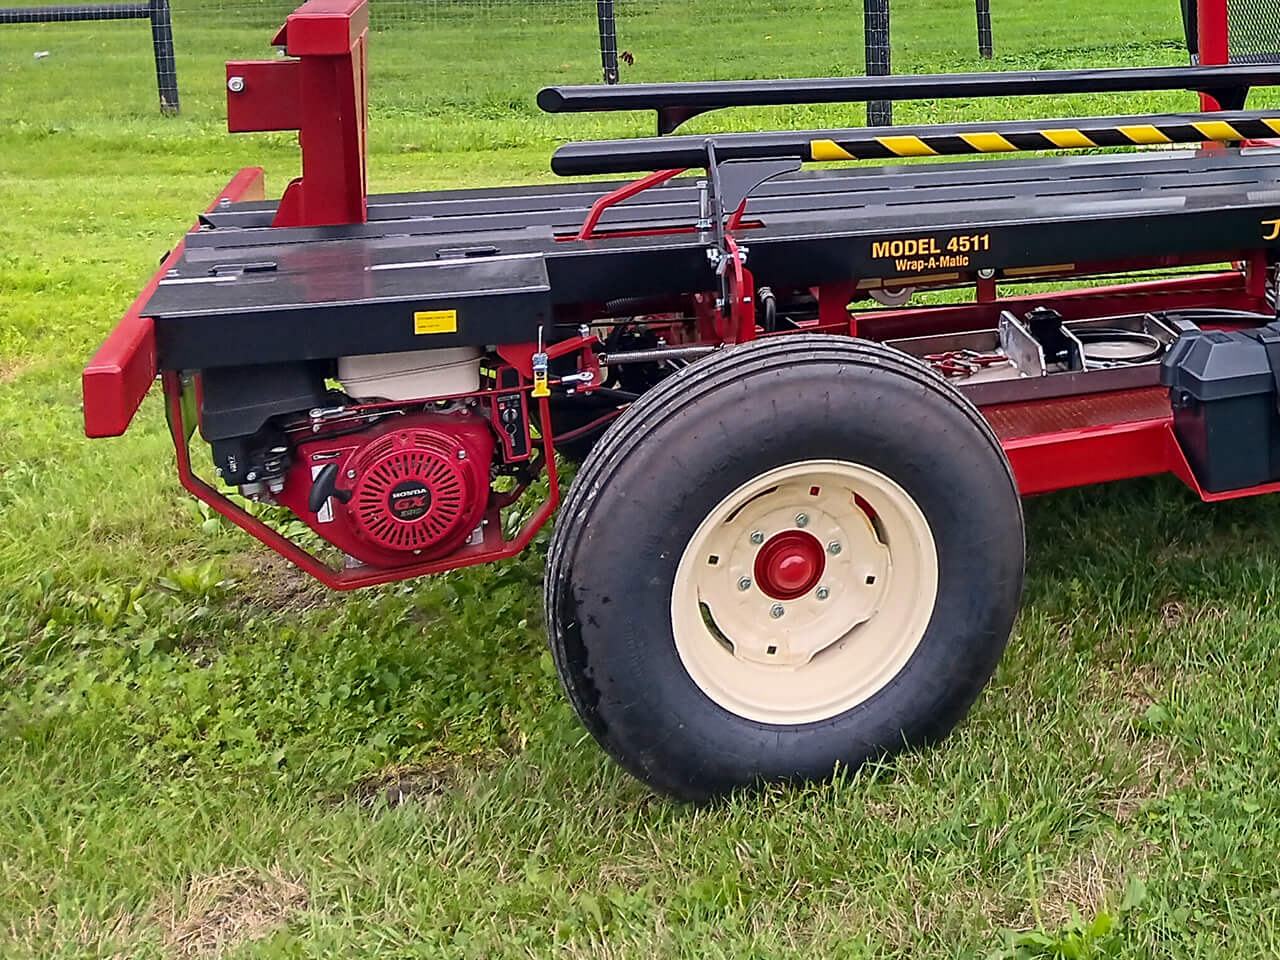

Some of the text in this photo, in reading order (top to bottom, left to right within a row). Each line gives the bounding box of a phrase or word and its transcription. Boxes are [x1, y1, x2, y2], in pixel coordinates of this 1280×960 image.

[872, 233, 990, 258] MODEL 4511
[895, 254, 969, 272] Wrap-A-Matic
[392, 488, 427, 498] HONDA
[394, 496, 427, 511] GX
